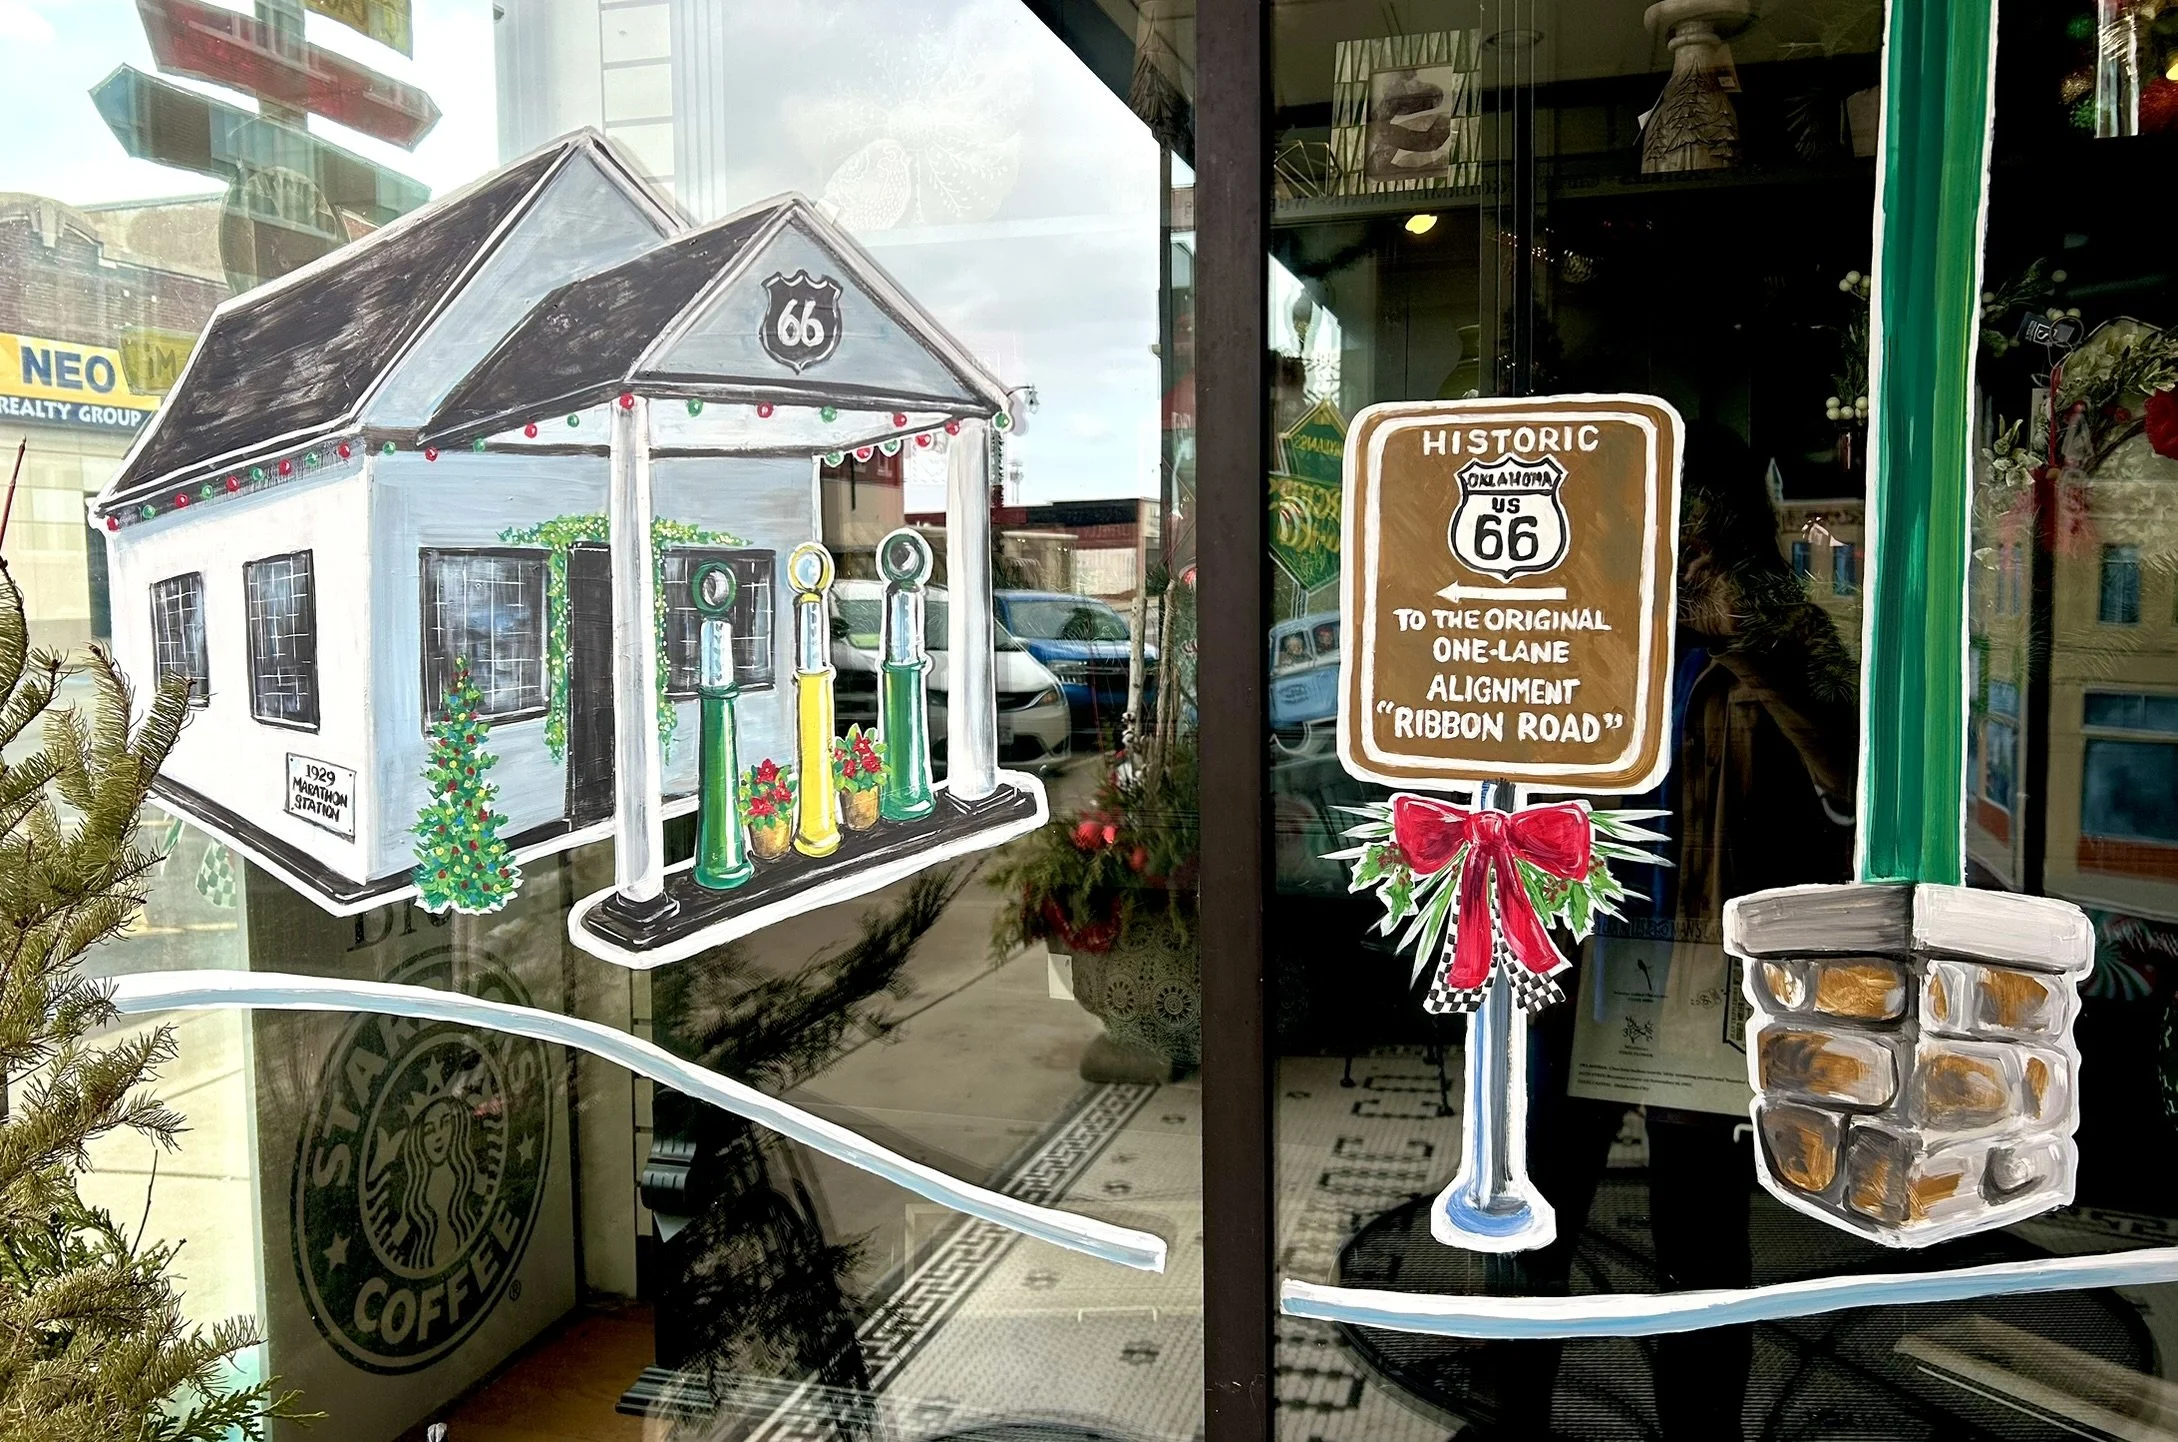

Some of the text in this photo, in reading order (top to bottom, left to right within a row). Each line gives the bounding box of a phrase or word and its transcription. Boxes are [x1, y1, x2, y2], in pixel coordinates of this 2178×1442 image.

[777, 298, 825, 347] 66
[20, 345, 116, 394] NEO
[0, 396, 142, 427] REALTY GROUP
[1423, 425, 1599, 456] HISTORIC
[1467, 471, 1553, 488] OKLAHOMA
[1491, 497, 1521, 514] US
[1474, 514, 1539, 562] 66
[1392, 607, 1612, 631] TO THE ORIGINAL
[1432, 636, 1570, 664] ONE-LANE
[1425, 672, 1581, 705] ALIGNMENT
[1376, 700, 1624, 743] "RIBBON ROAD"
[305, 764, 336, 787] 1929
[293, 776, 348, 808] MARATHON
[294, 794, 340, 822] STATION
[312, 976, 537, 1188] STARS
[353, 1199, 521, 1346] COFFEE
